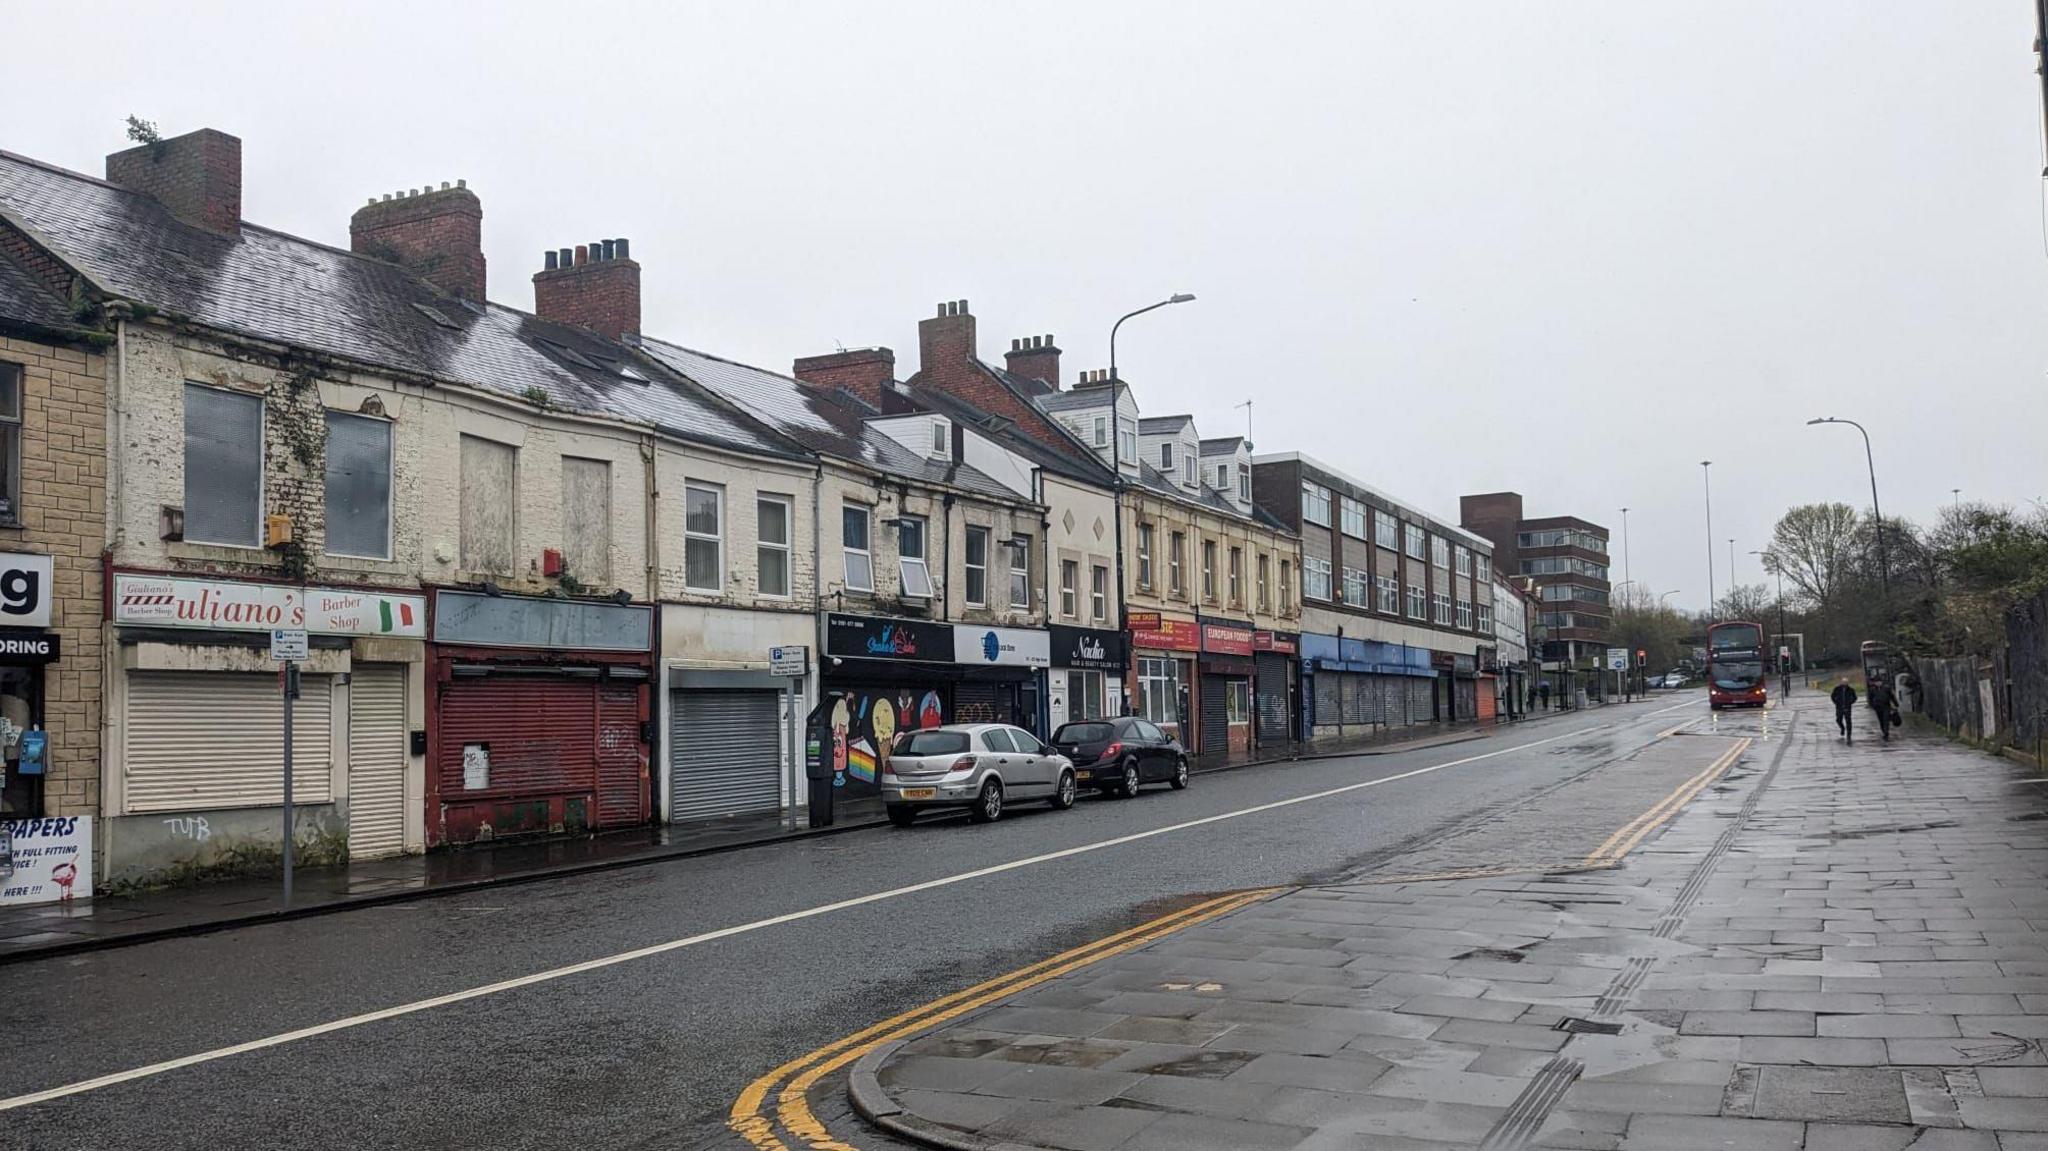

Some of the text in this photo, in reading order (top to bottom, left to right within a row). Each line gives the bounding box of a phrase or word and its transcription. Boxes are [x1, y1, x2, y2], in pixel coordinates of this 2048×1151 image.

[0, 569, 39, 615] g
[127, 583, 173, 594] Giuliano's
[322, 596, 361, 612] Barber
[330, 616, 360, 631] Shop
[1208, 628, 1233, 641] EUROPEAN
[1072, 636, 1106, 659] Nadia
[23, 848, 43, 857] FULL
[45, 845, 78, 856] FITTING
[4, 887, 29, 897] HERE
